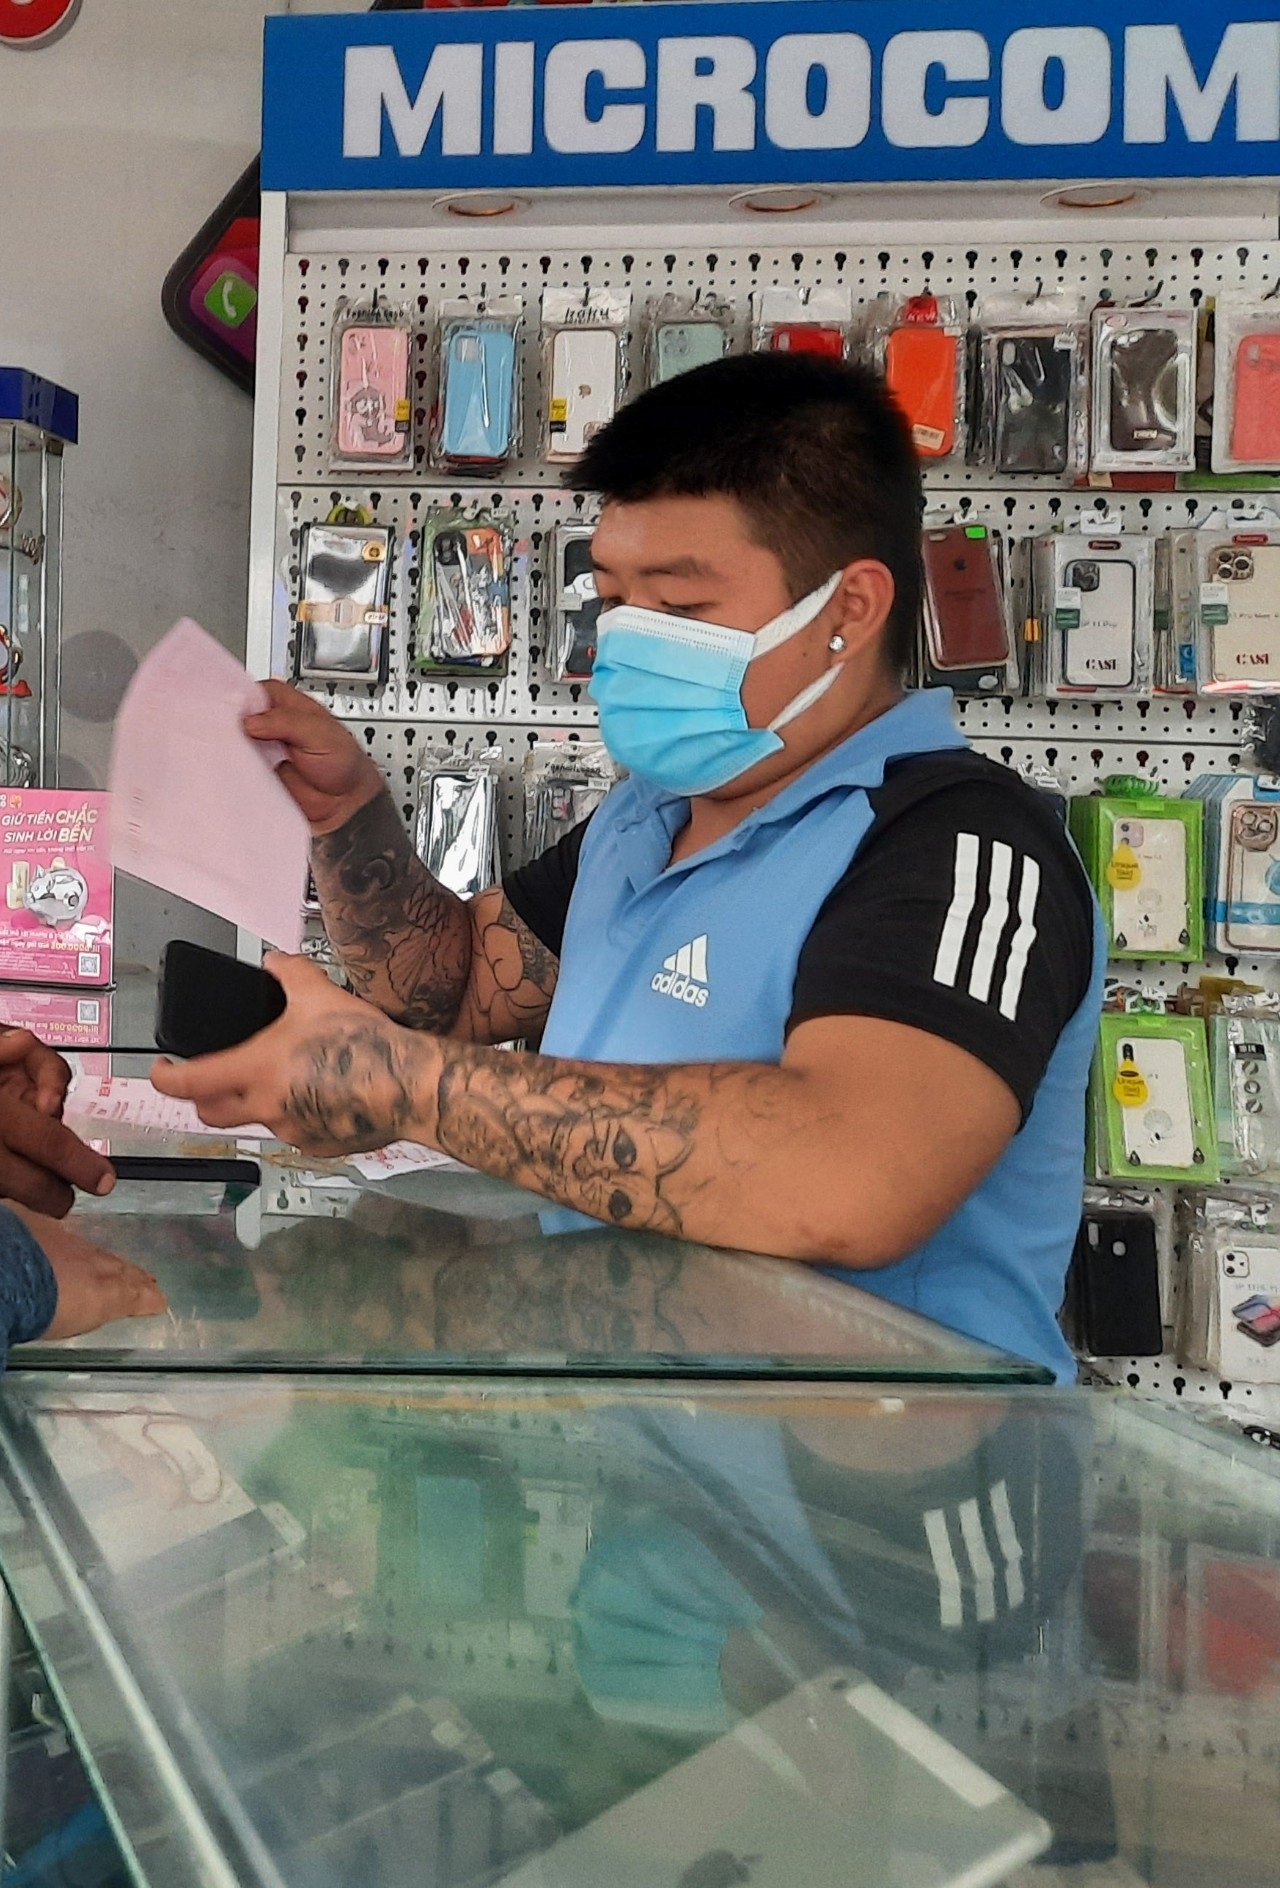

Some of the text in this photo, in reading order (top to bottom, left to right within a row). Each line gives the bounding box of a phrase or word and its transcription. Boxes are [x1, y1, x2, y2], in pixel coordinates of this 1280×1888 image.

[342, 22, 1280, 158] MICROCOM
[4, 831, 34, 843] SINH
[650, 971, 710, 1008] adidas
